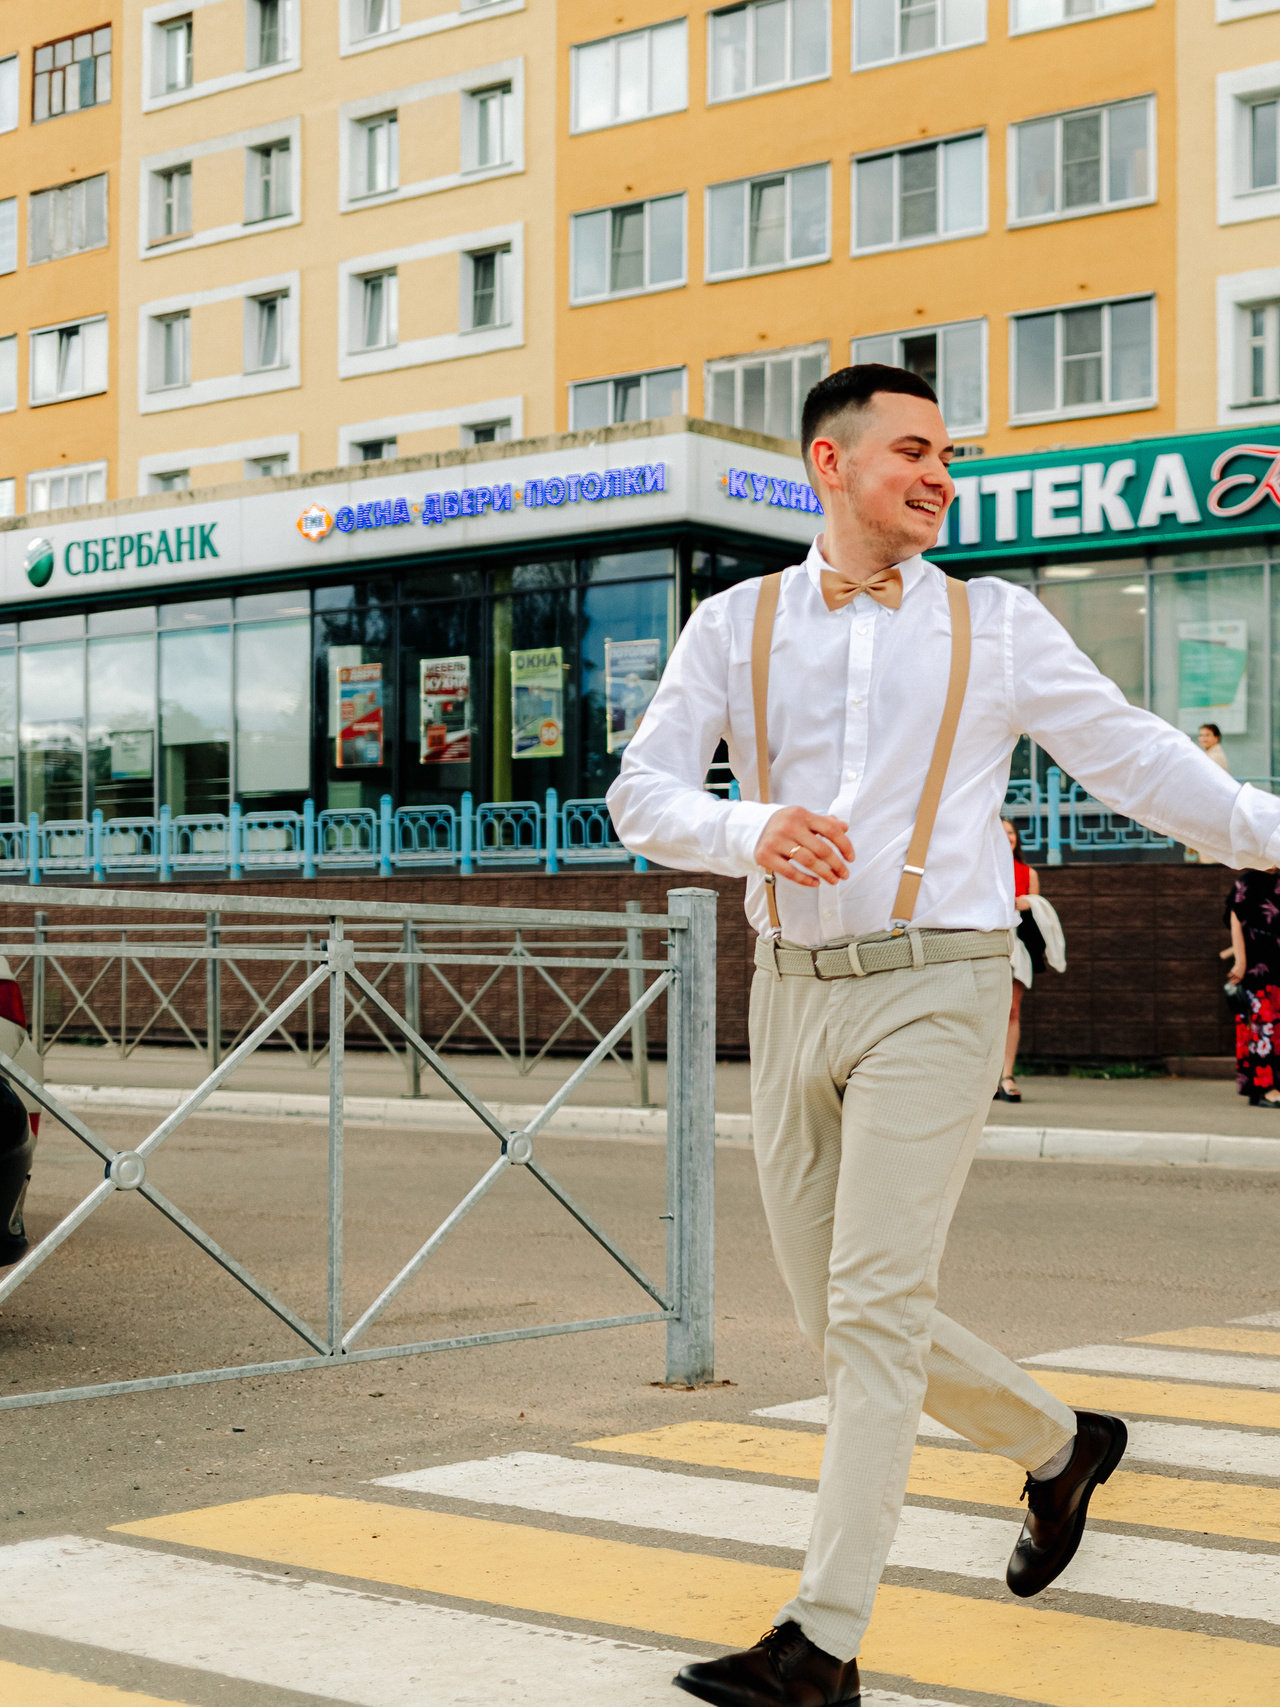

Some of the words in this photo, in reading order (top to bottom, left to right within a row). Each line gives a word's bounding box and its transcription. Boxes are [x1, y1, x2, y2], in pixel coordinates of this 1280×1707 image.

[335, 496, 411, 533] ОКНА
[422, 483, 513, 526] ДВЕРИ
[524, 462, 666, 508] ПОТОЛКИ
[932, 452, 1202, 549] ПТЕКА
[64, 520, 220, 577] СБЕРБАНК
[425, 661, 467, 674] МЕБЕЛЬ
[515, 652, 558, 671] ОКНА
[425, 674, 469, 691] КУХНИ
